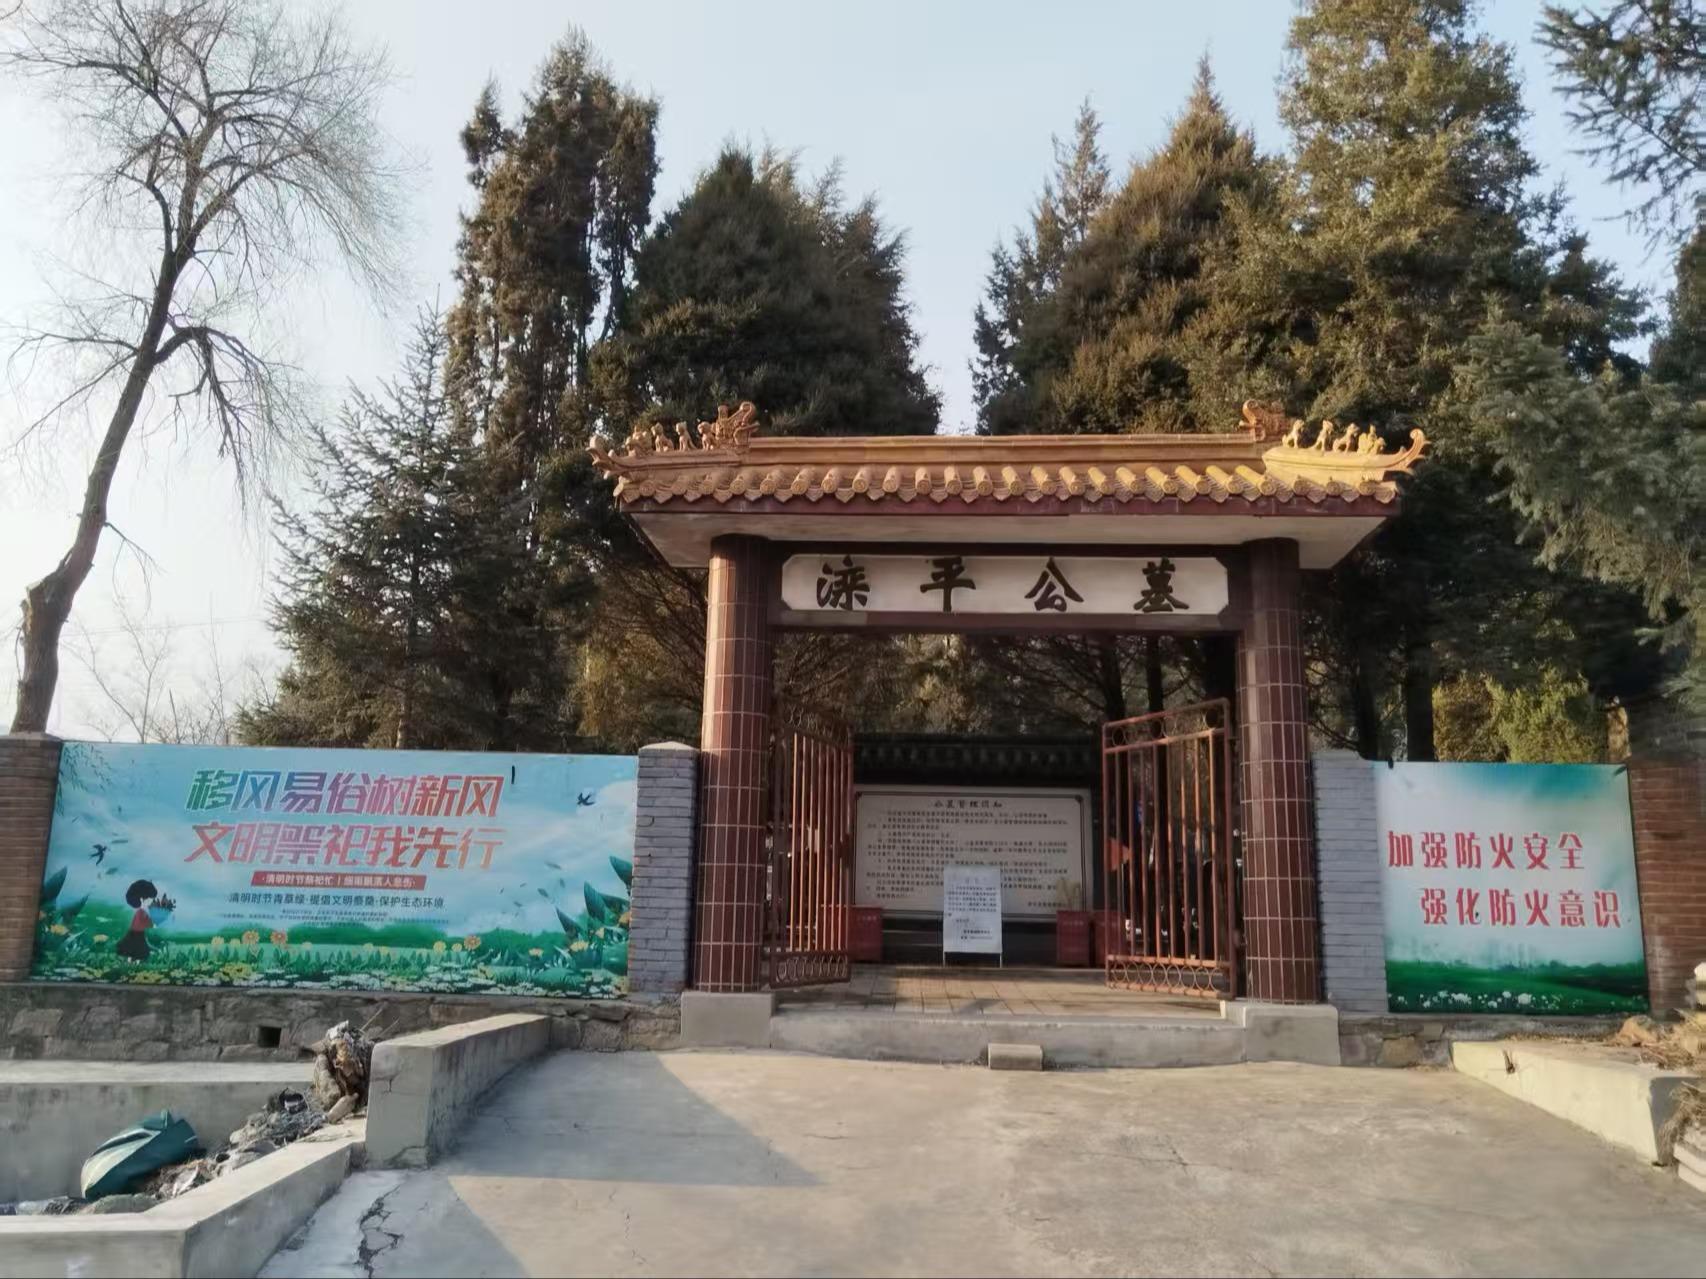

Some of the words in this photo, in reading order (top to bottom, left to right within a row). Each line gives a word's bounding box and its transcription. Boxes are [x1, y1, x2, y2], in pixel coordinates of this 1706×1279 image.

[816, 555, 1190, 612] 滦平公墓
[185, 769, 505, 817] 移风易俗树新风
[184, 821, 506, 869] 文明祭祀我先行
[1388, 831, 1585, 869] 加强防火安全
[1421, 888, 1621, 928] 强化防火意识
